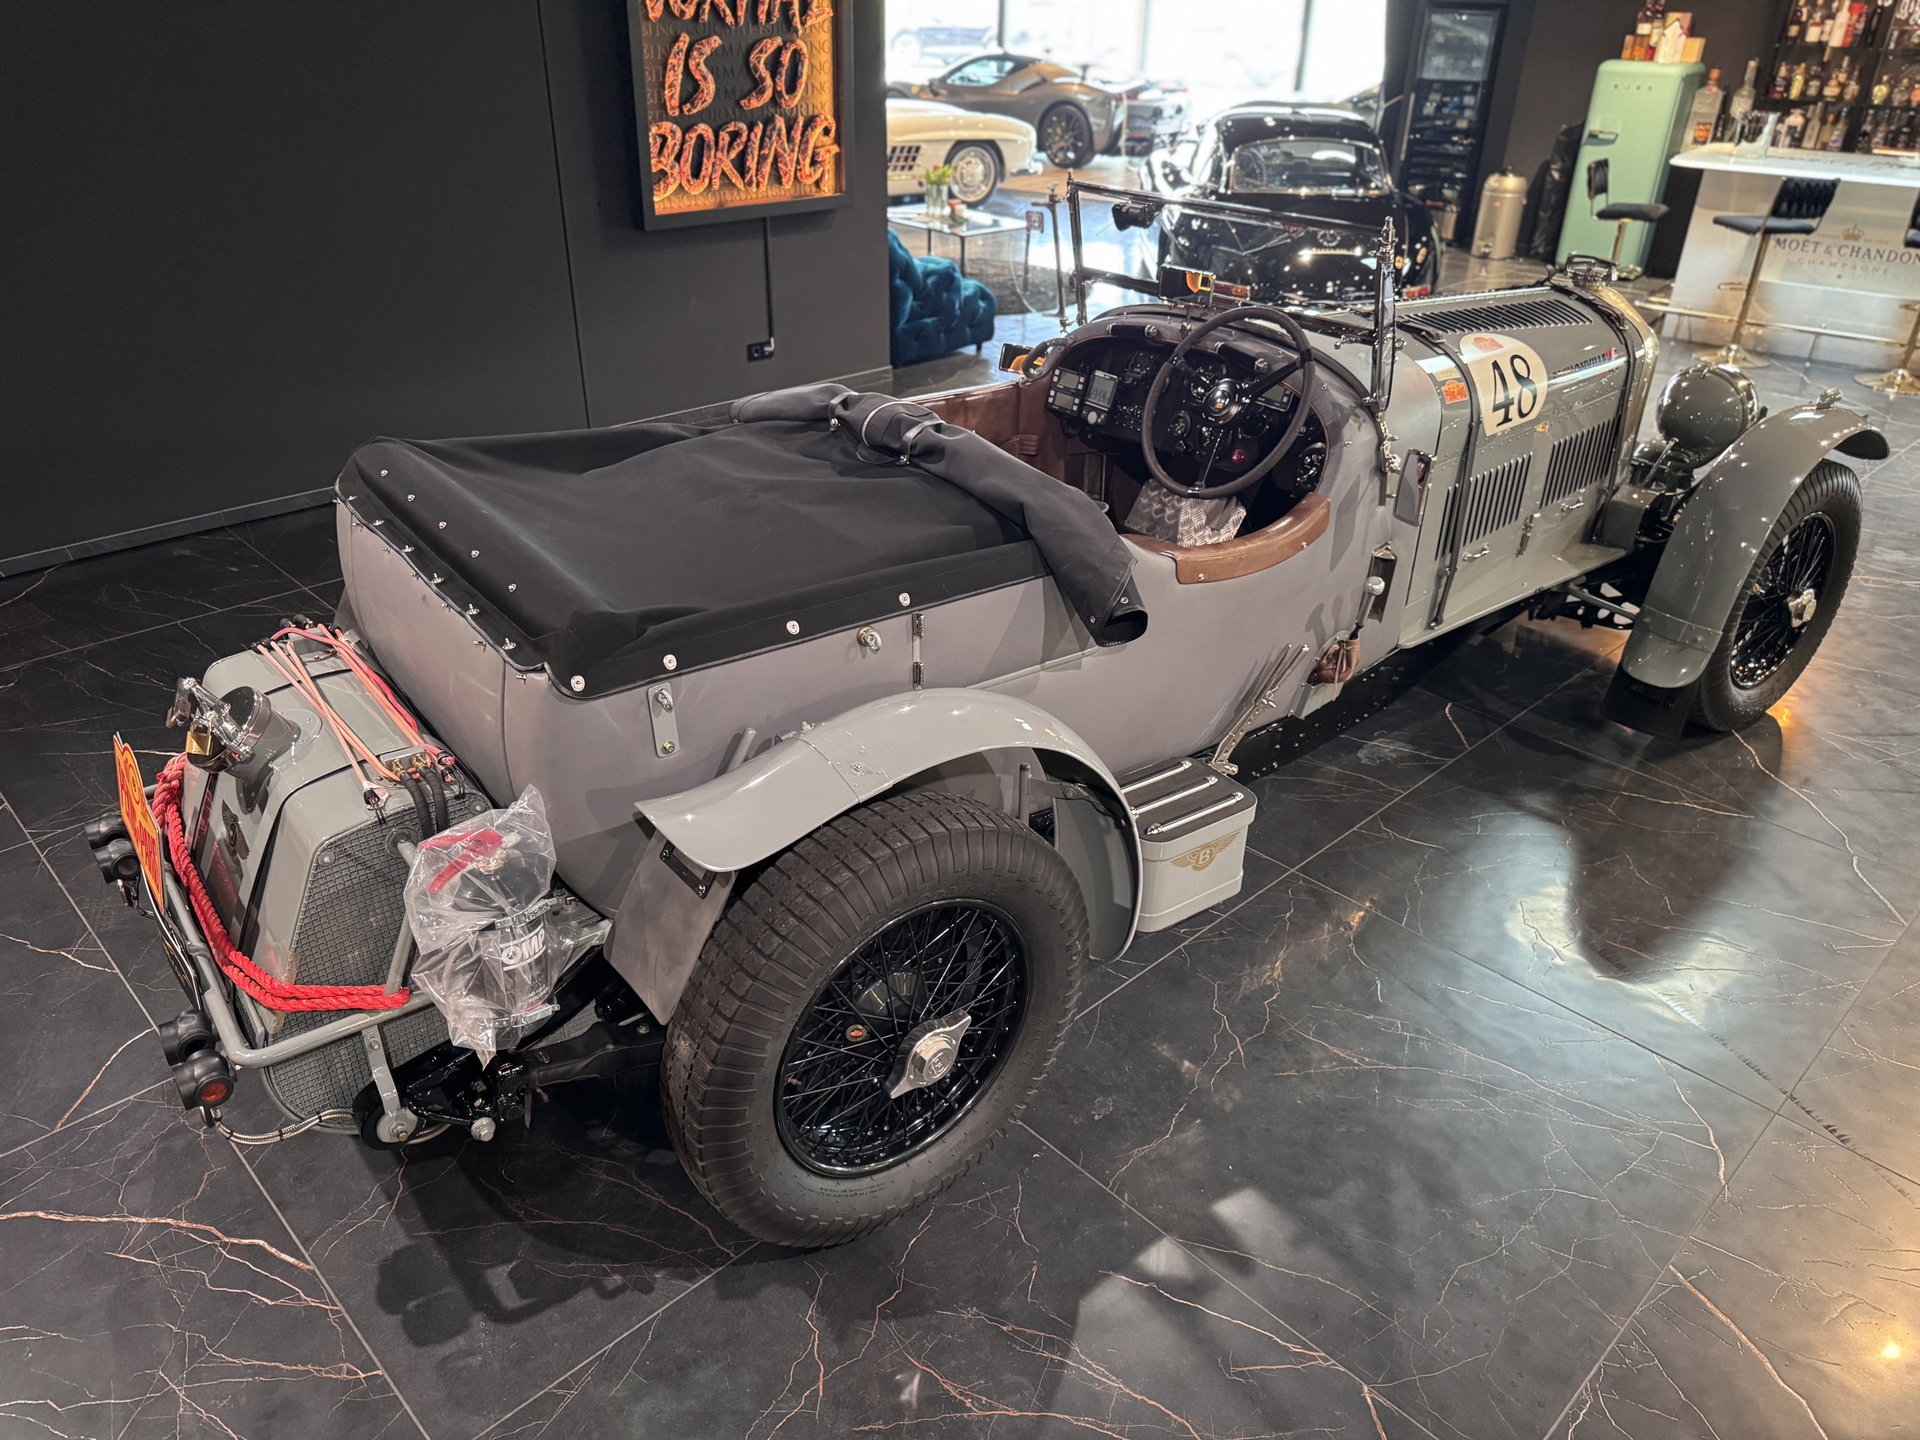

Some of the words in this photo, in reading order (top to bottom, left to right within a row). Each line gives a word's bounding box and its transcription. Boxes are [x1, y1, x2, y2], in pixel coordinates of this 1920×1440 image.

[664, 32, 723, 116] IS
[739, 36, 809, 110] SO
[649, 113, 840, 202] BORING
[1823, 244, 1833, 256] &
[1491, 354, 1538, 428] 48
[501, 927, 546, 966] OMP
